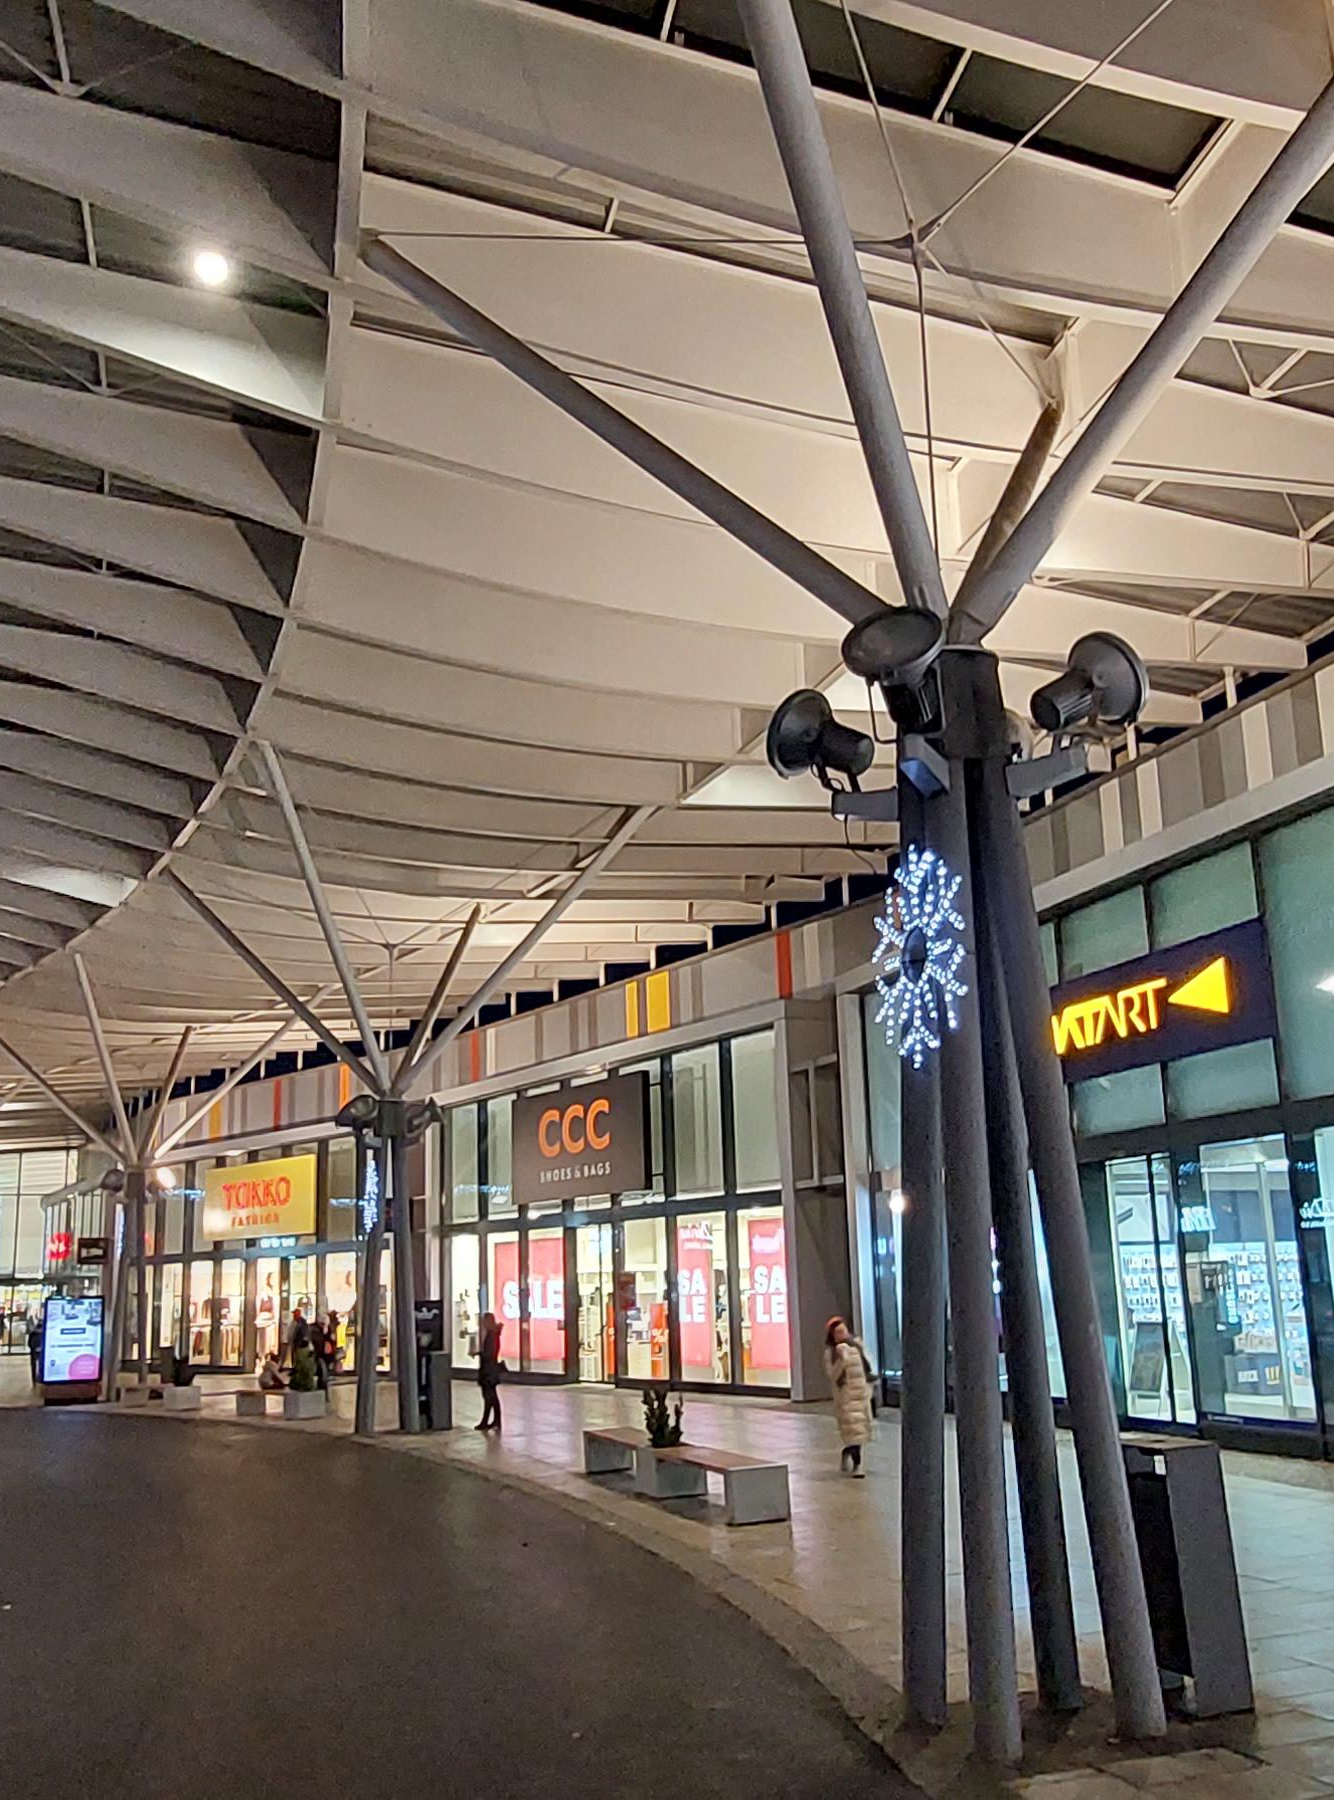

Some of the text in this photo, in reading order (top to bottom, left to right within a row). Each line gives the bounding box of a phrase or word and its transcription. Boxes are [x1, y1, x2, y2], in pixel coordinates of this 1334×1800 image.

[538, 1098, 611, 1158] CCC
[539, 1161, 611, 1184] SHOES & BAGS
[222, 1176, 291, 1211] TOKKO
[754, 1265, 787, 1294] SA
[756, 1294, 786, 1323] LE
